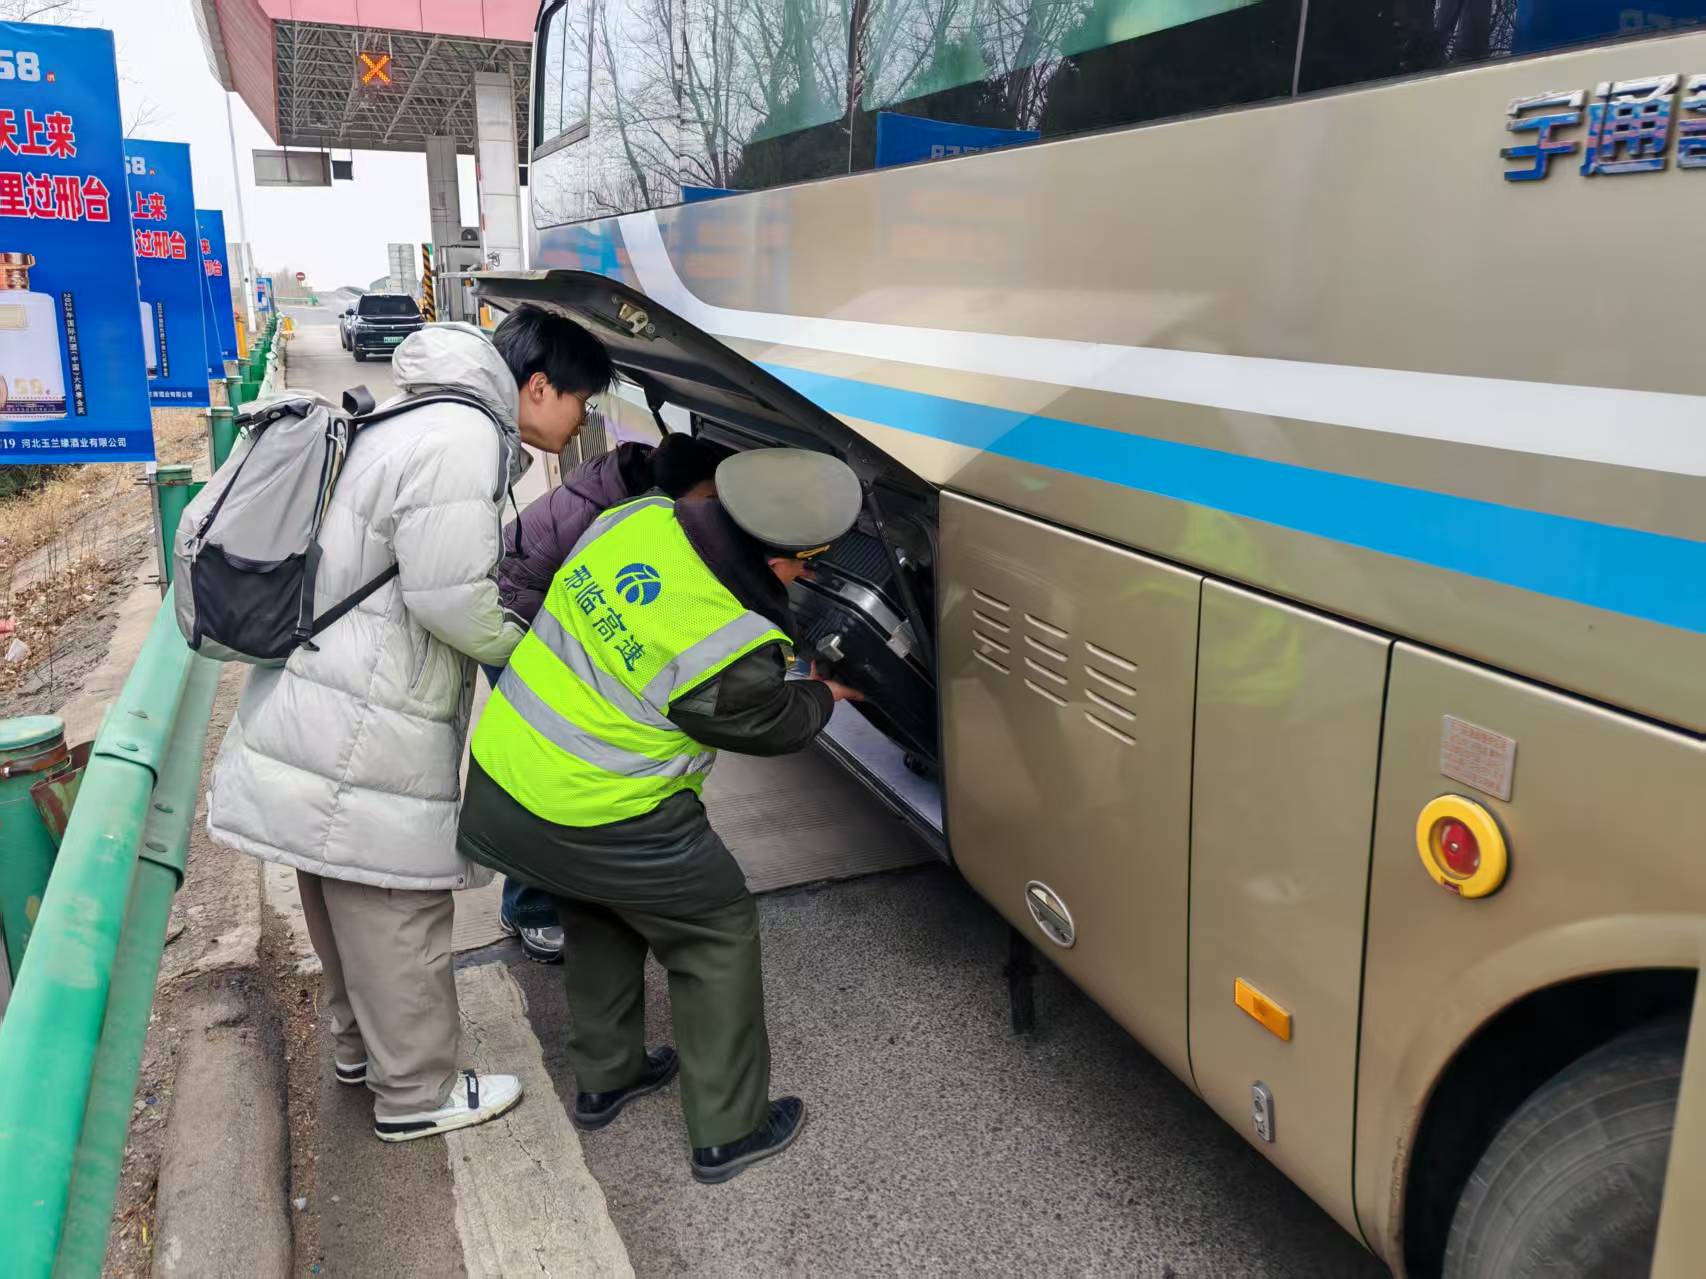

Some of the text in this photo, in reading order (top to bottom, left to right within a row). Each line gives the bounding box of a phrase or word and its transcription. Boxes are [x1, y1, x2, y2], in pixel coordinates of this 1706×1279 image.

[0, 108, 77, 158] 天上来
[0, 171, 110, 222] 里过邢台
[132, 191, 167, 221] 上来
[135, 229, 186, 260] 过邢台
[0, 437, 127, 449] 19 河北玉兰缘酒业有限公司
[563, 564, 645, 672] 邢临高速
